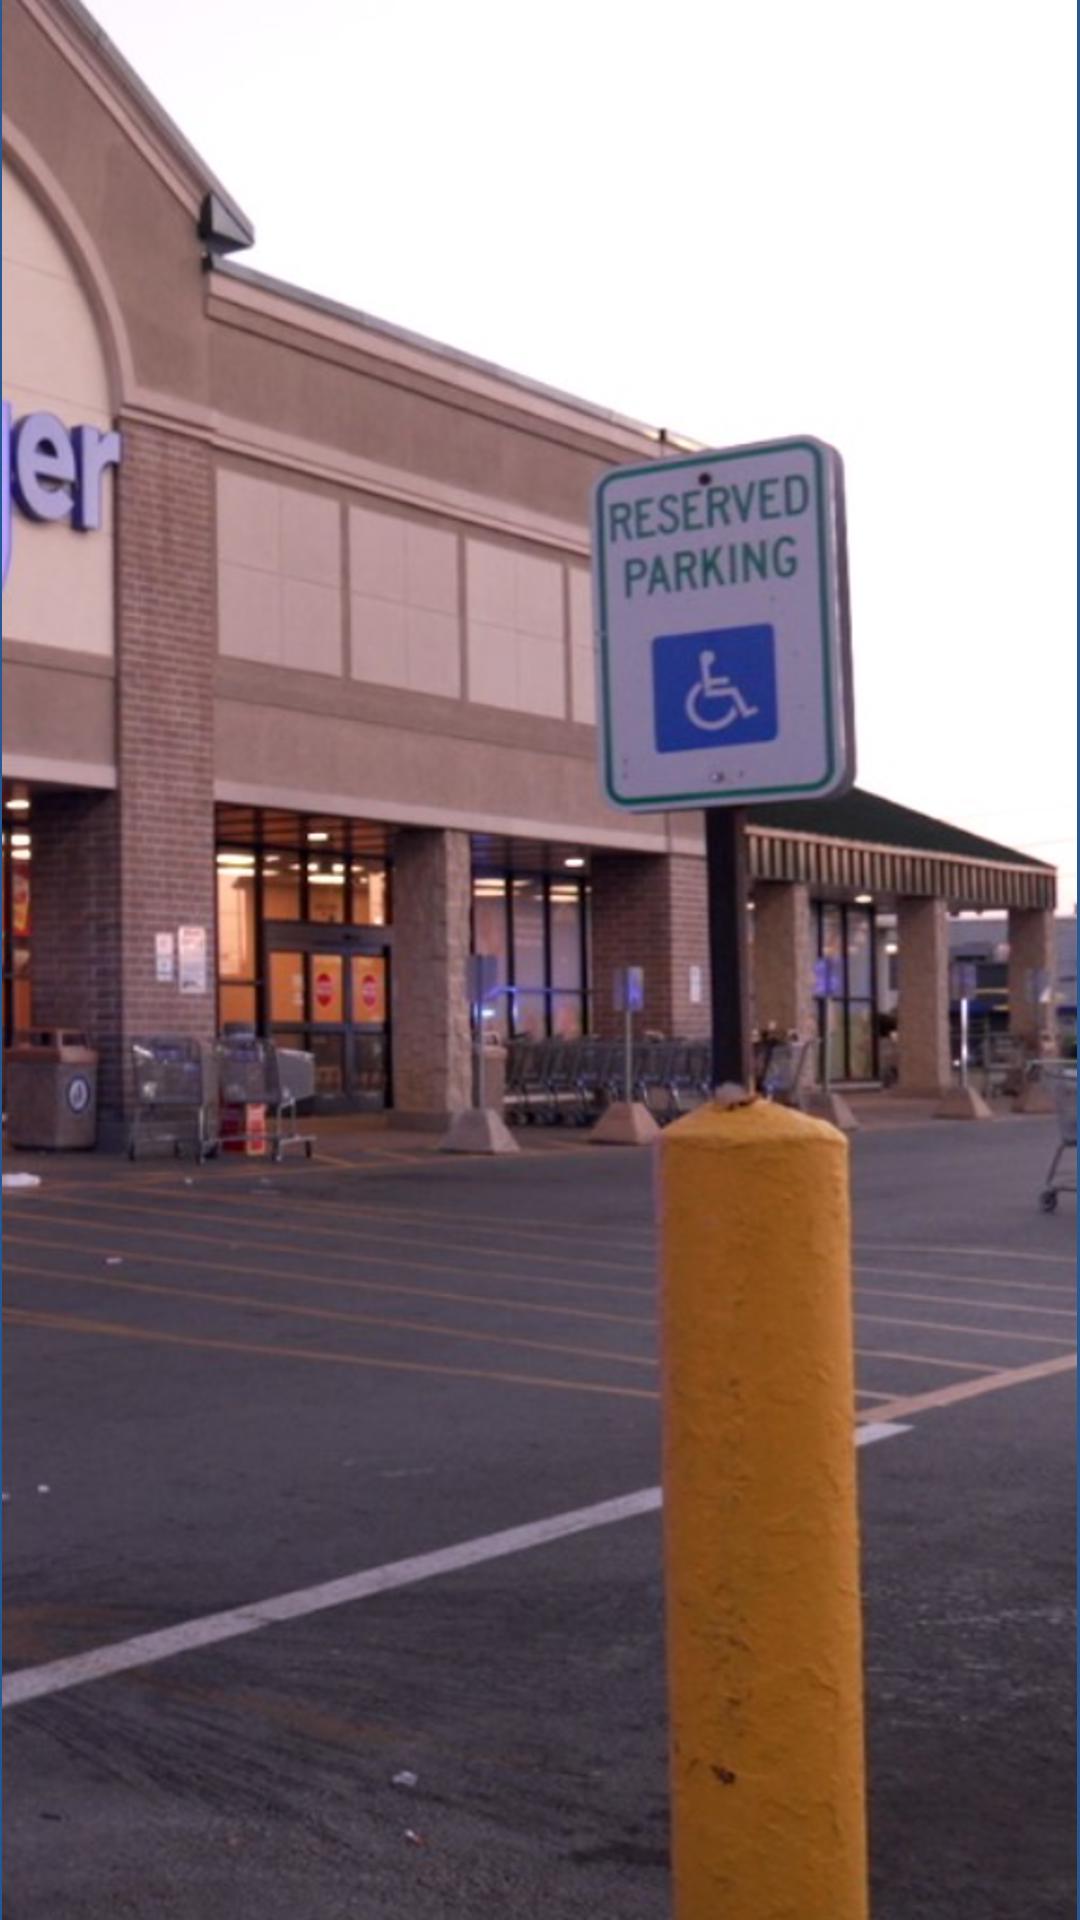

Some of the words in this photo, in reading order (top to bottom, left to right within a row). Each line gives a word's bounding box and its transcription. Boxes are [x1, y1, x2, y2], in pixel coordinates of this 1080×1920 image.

[2, 399, 121, 592] er
[609, 474, 809, 543] RESERVED
[624, 535, 797, 598] PARKING
